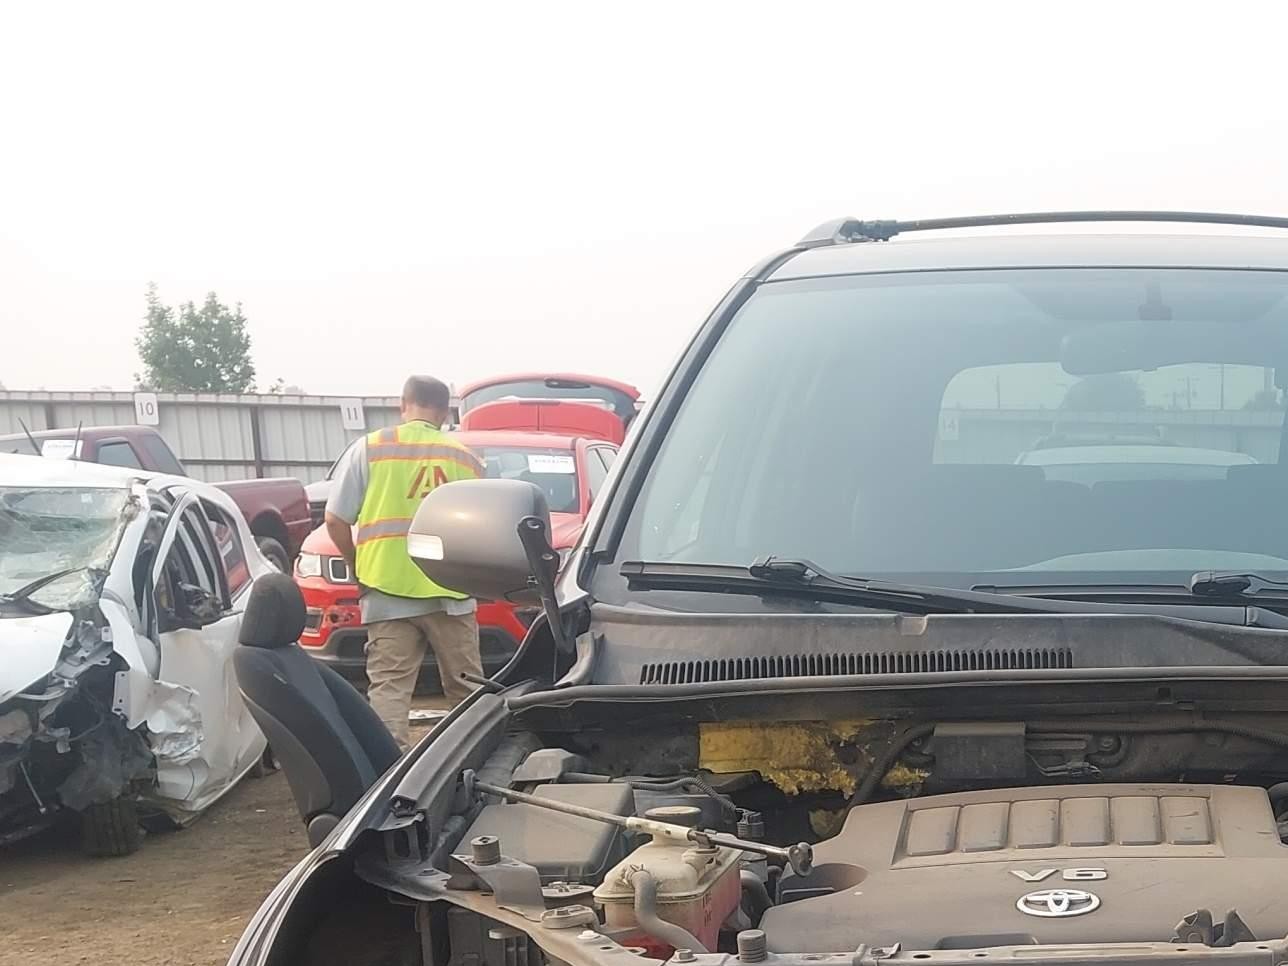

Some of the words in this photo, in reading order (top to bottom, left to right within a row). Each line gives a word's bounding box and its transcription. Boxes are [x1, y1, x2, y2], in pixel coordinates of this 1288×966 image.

[139, 401, 154, 417] 10
[347, 407, 358, 421] 11
[1009, 867, 1108, 882] V6
